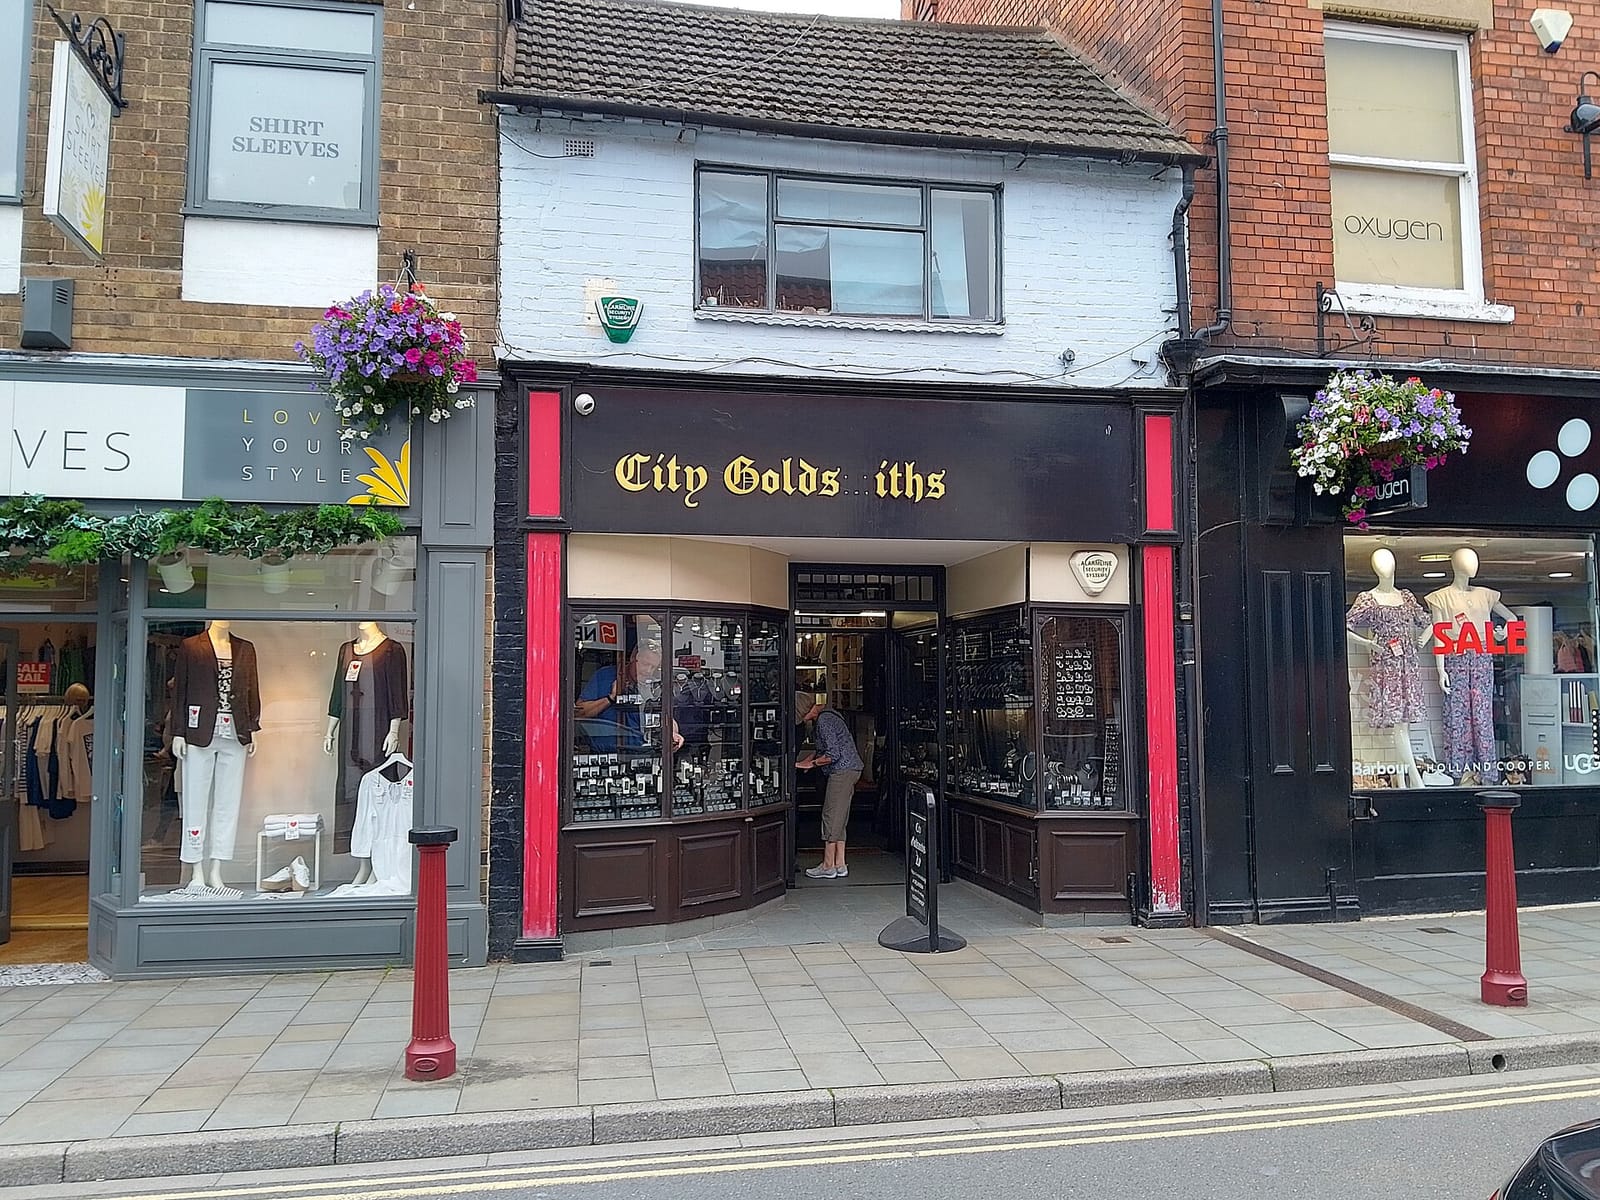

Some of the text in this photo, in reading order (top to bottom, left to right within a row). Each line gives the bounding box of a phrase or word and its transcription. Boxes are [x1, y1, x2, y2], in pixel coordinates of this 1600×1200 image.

[249, 116, 324, 136] SHIRT
[74, 114, 101, 161] SHIRT
[231, 136, 340, 159] SLEEVES
[66, 130, 105, 189] SLEEVES
[1344, 215, 1443, 241] oxygen
[242, 408, 351, 427] LOVE
[241, 437, 352, 455] YOUR
[241, 466, 351, 483] STYLE
[614, 452, 708, 508] City
[1432, 621, 1528, 655] SALE
[1353, 761, 1411, 775] Barbour
[1426, 761, 1491, 773] HOLLAND
[1496, 760, 1551, 772] COOPER
[1564, 753, 1600, 775] UGG
